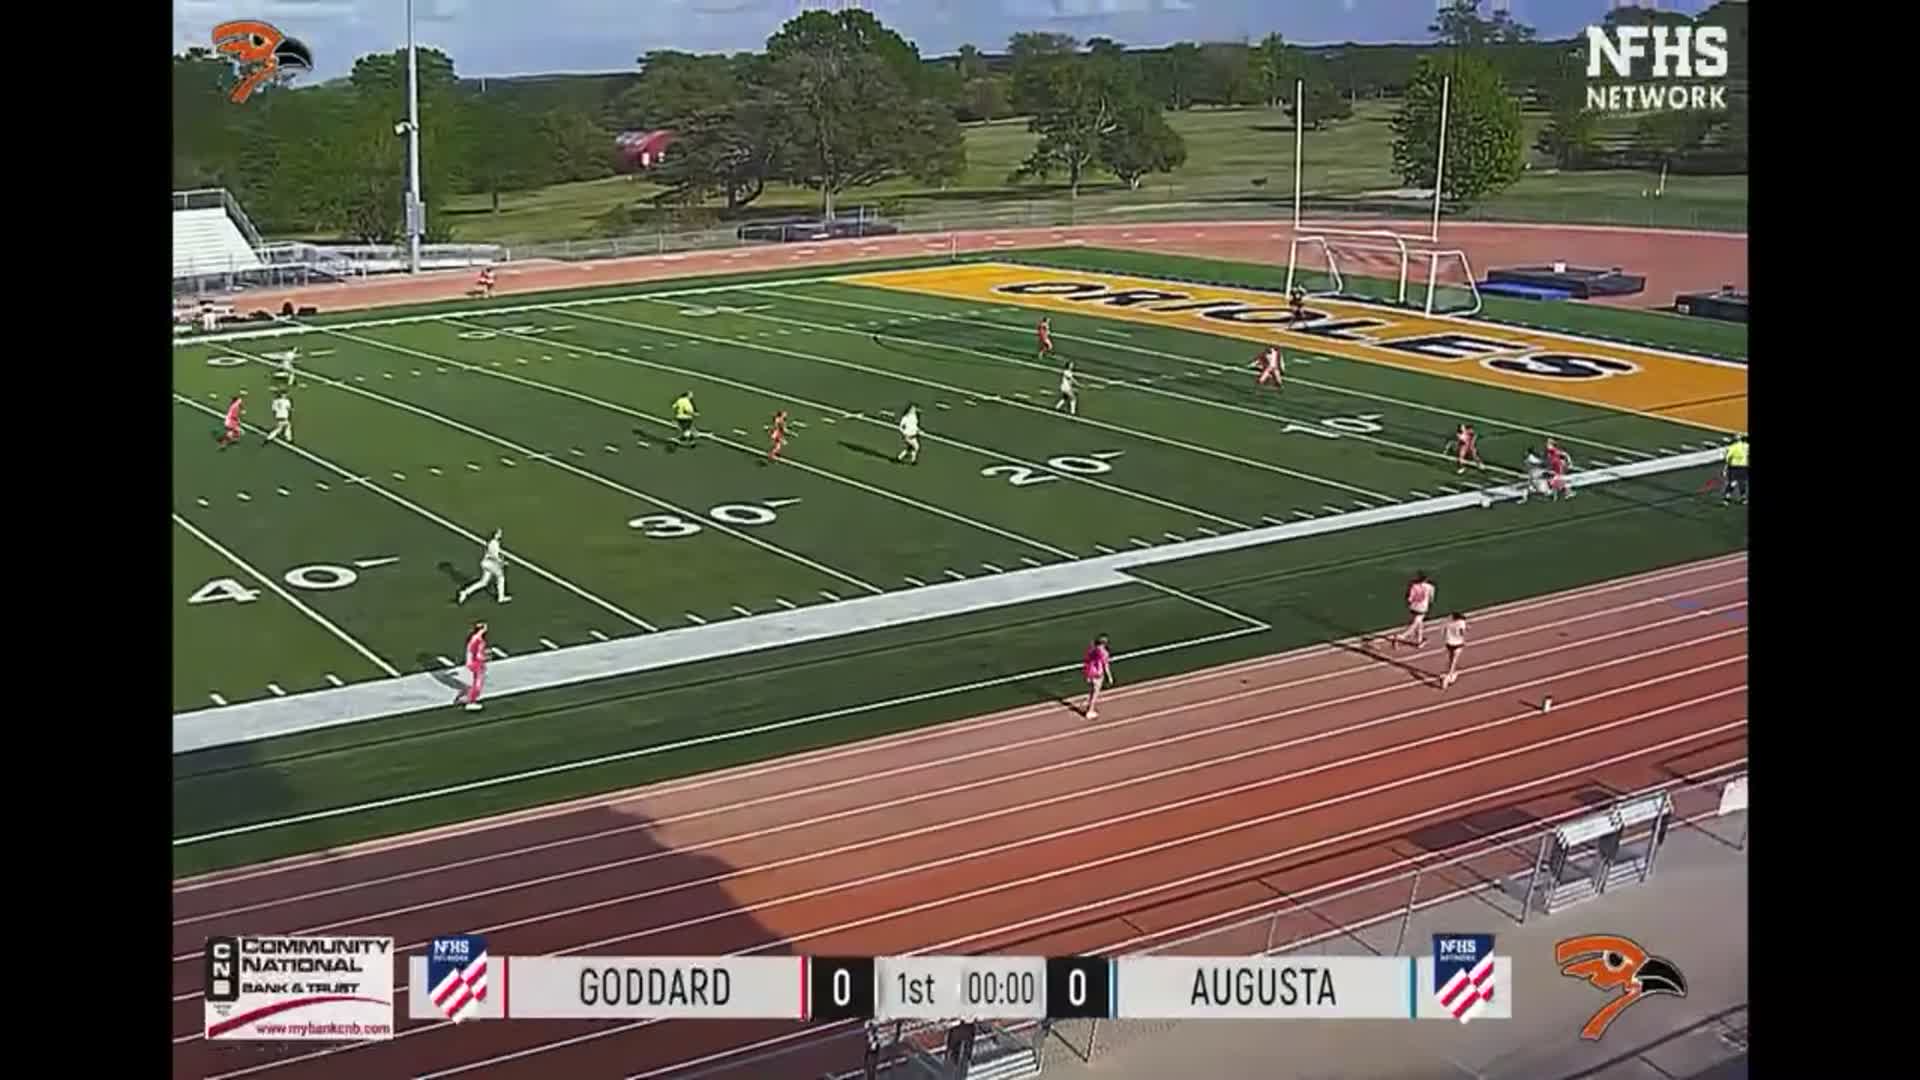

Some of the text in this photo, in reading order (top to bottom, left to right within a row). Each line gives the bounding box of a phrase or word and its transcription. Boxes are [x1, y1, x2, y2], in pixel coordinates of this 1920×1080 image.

[990, 281, 1642, 380] ORIOLES
[980, 456, 1112, 485] 20
[628, 504, 777, 537] 30
[187, 564, 358, 603] 40
